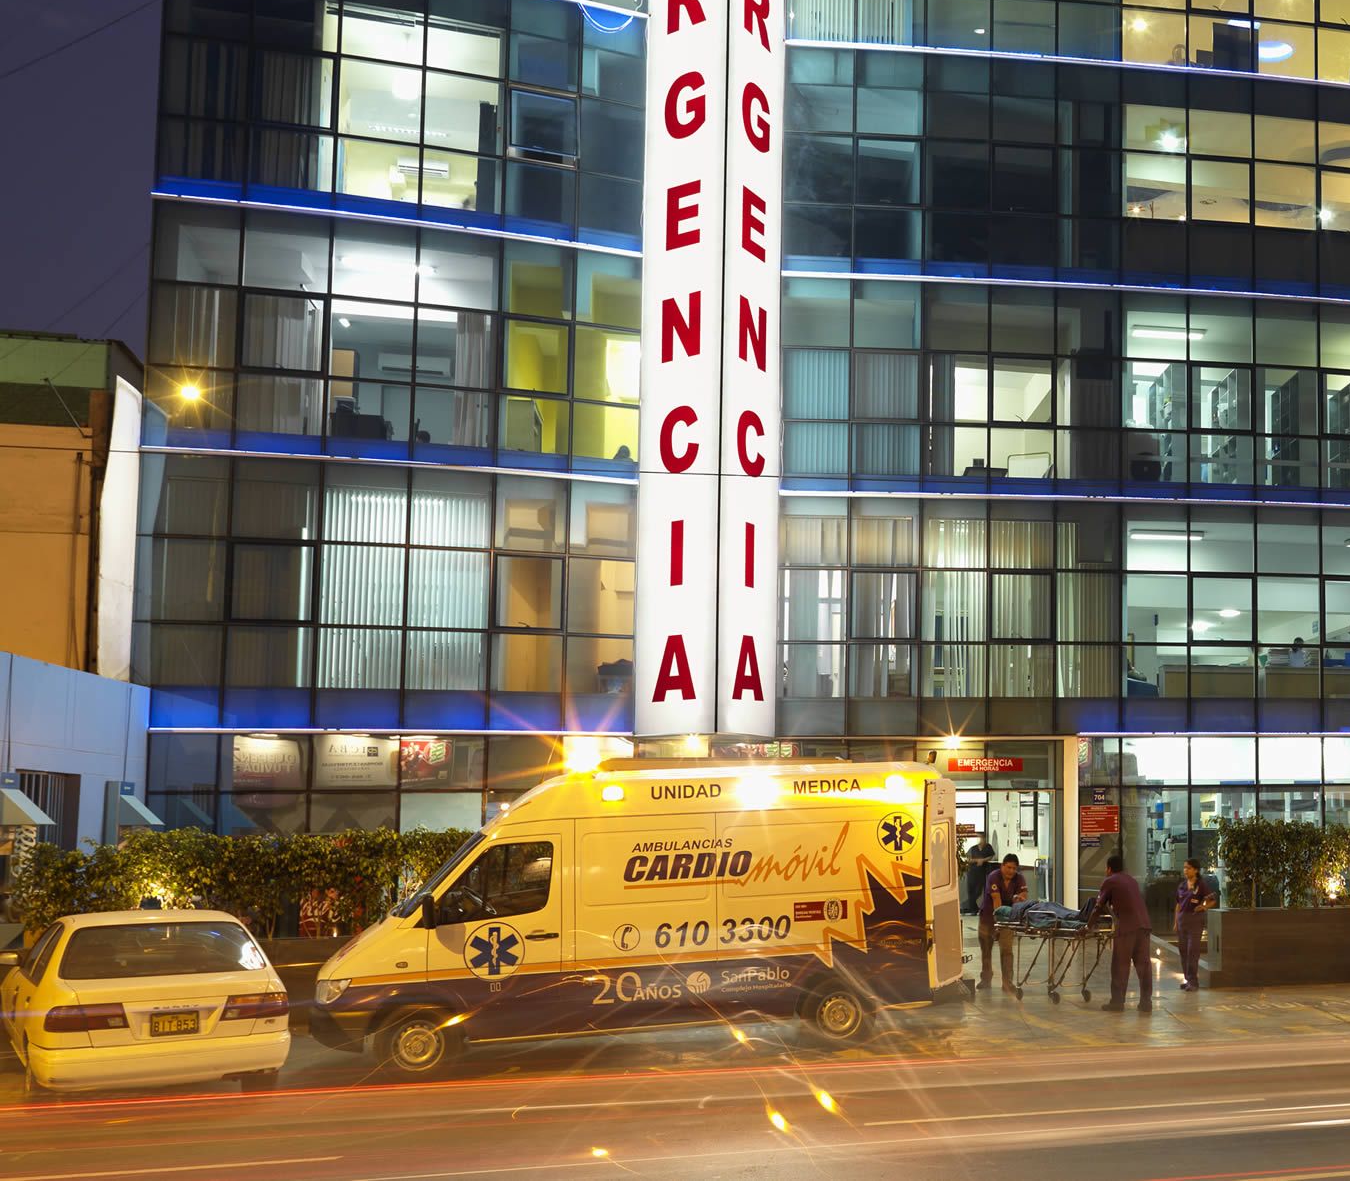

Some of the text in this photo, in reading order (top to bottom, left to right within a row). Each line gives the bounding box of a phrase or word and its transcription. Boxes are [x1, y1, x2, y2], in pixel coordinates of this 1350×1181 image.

[957, 758, 1014, 768] EMERGENCIA
[650, 778, 862, 800] UNIDAD MEDICA
[1094, 794, 1105, 802] 704
[632, 838, 733, 853] AMBULANCIAS
[654, 914, 791, 948] 610 3300
